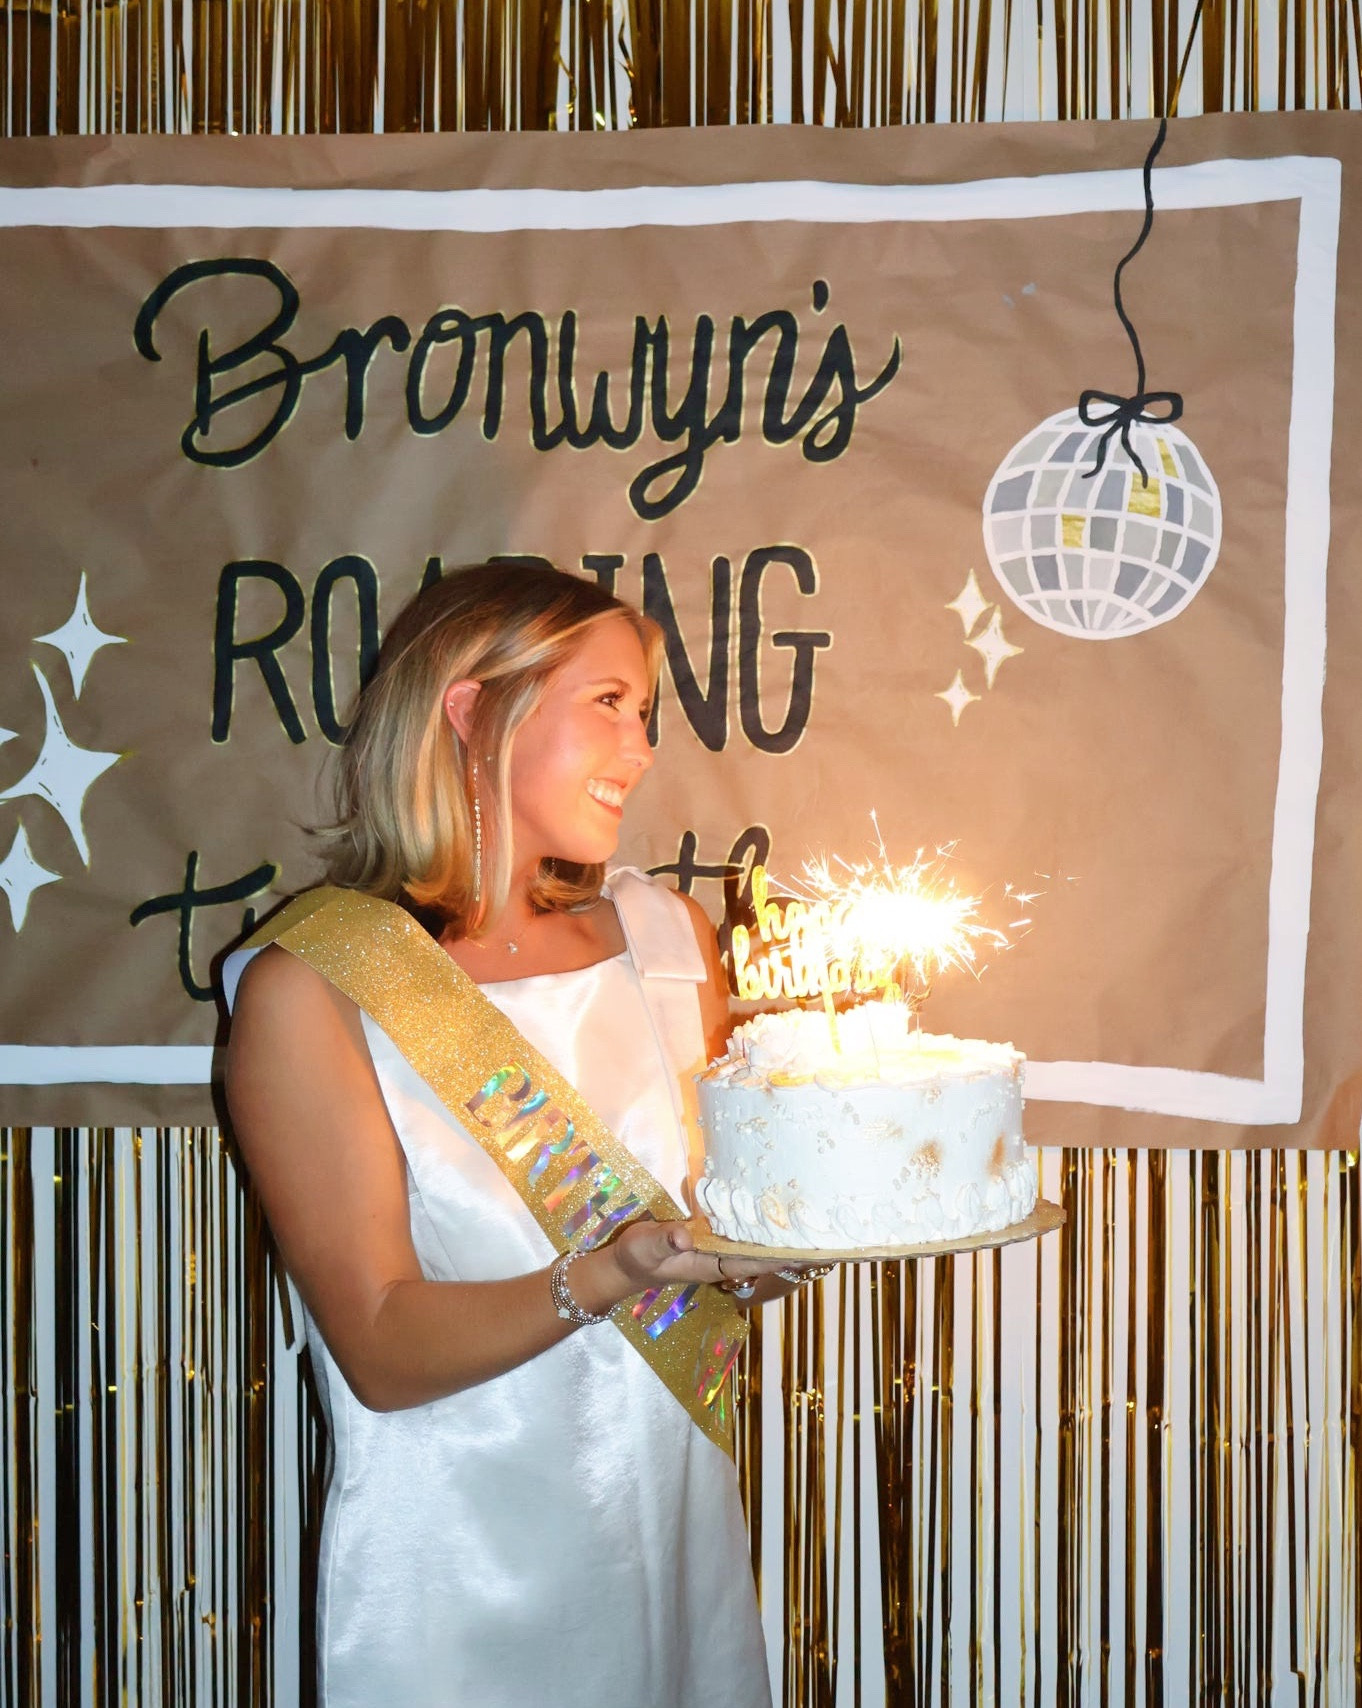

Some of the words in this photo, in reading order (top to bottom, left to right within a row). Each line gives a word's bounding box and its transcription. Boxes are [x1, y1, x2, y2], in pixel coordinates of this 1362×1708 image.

[132, 257, 901, 520] Bronwyn's
[210, 544, 833, 753] RONG
[464, 1059, 699, 1342] BIRTHY
